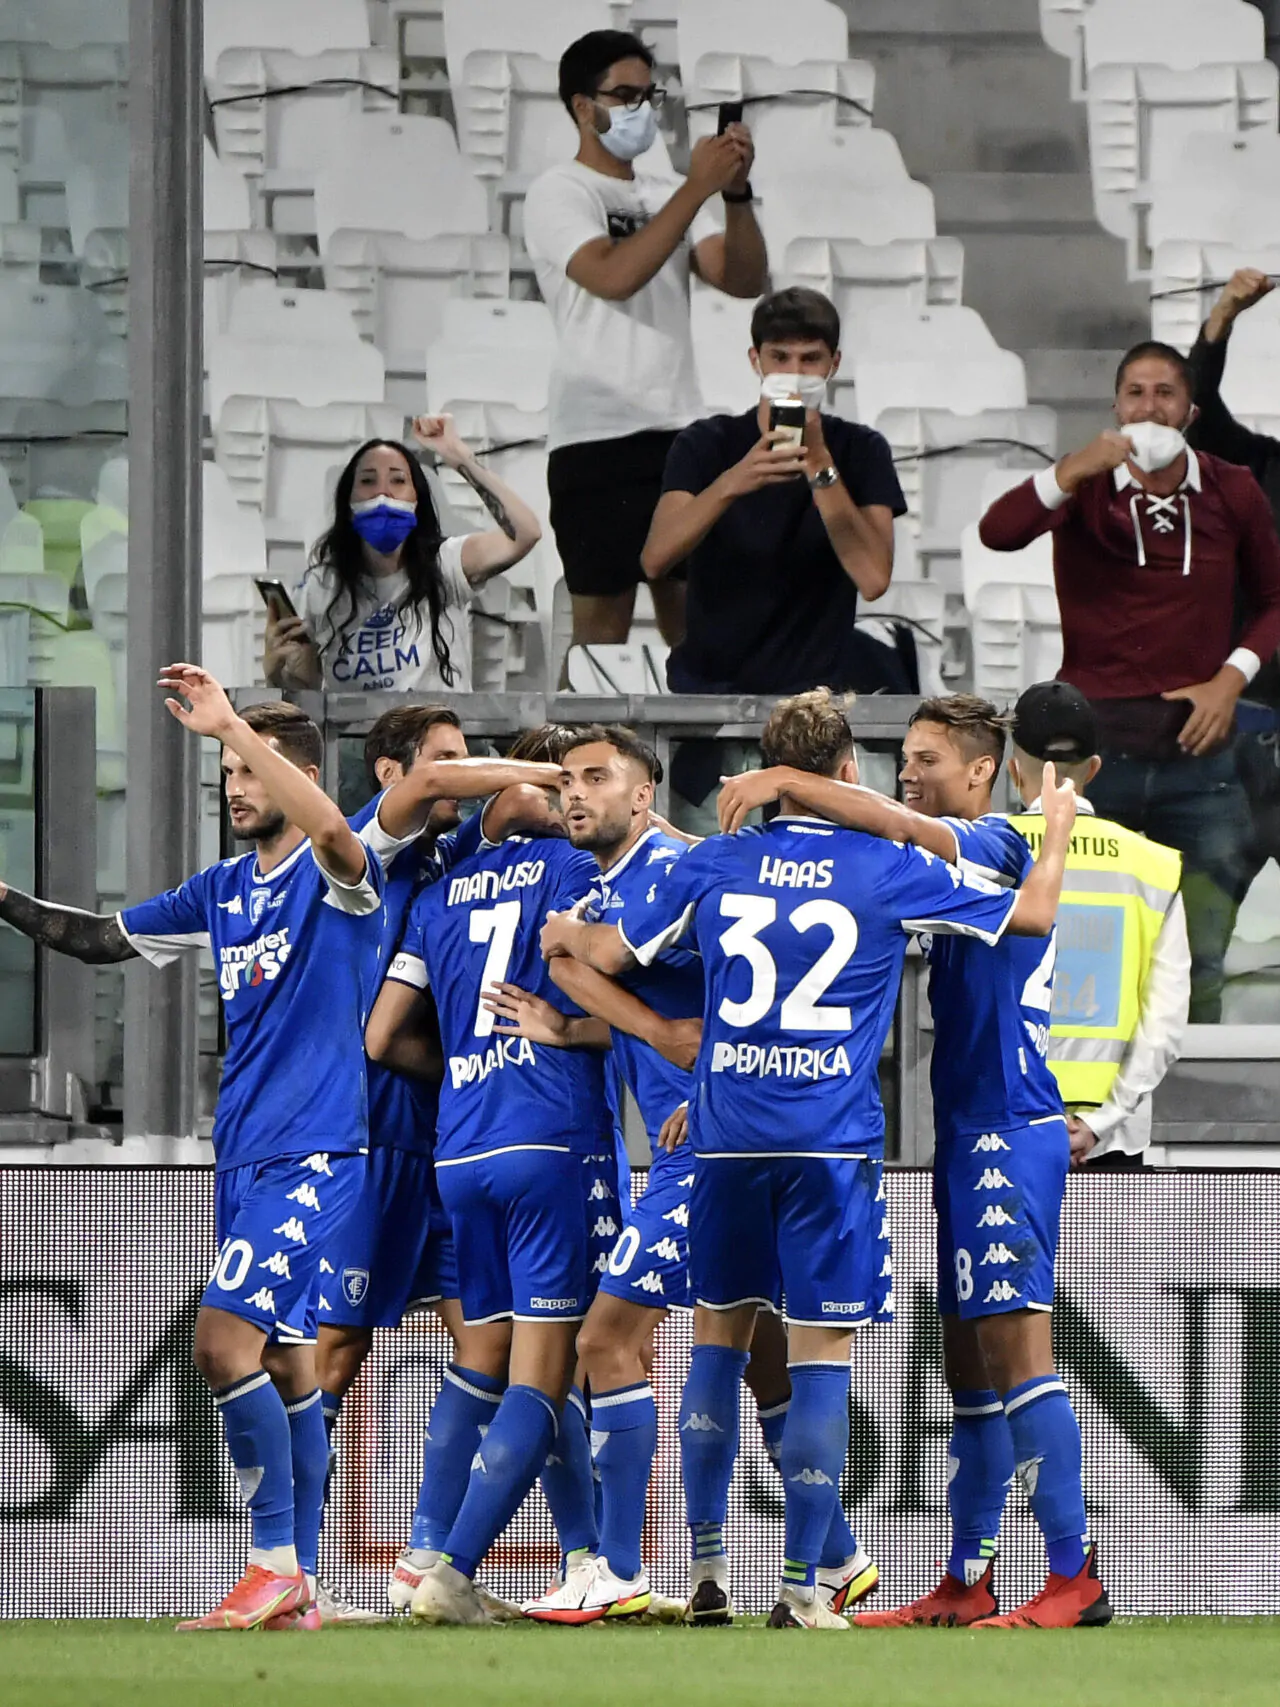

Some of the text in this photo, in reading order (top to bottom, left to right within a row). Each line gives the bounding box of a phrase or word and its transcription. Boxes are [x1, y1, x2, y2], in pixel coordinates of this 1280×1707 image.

[333, 644, 420, 681] CALM
[447, 860, 545, 906] MANUSO
[758, 855, 834, 889] HAAS
[469, 900, 521, 1037] 7
[718, 893, 859, 1031] 32
[711, 1042, 852, 1081] PEDIATRICA
[531, 1297, 577, 1310] Kappa
